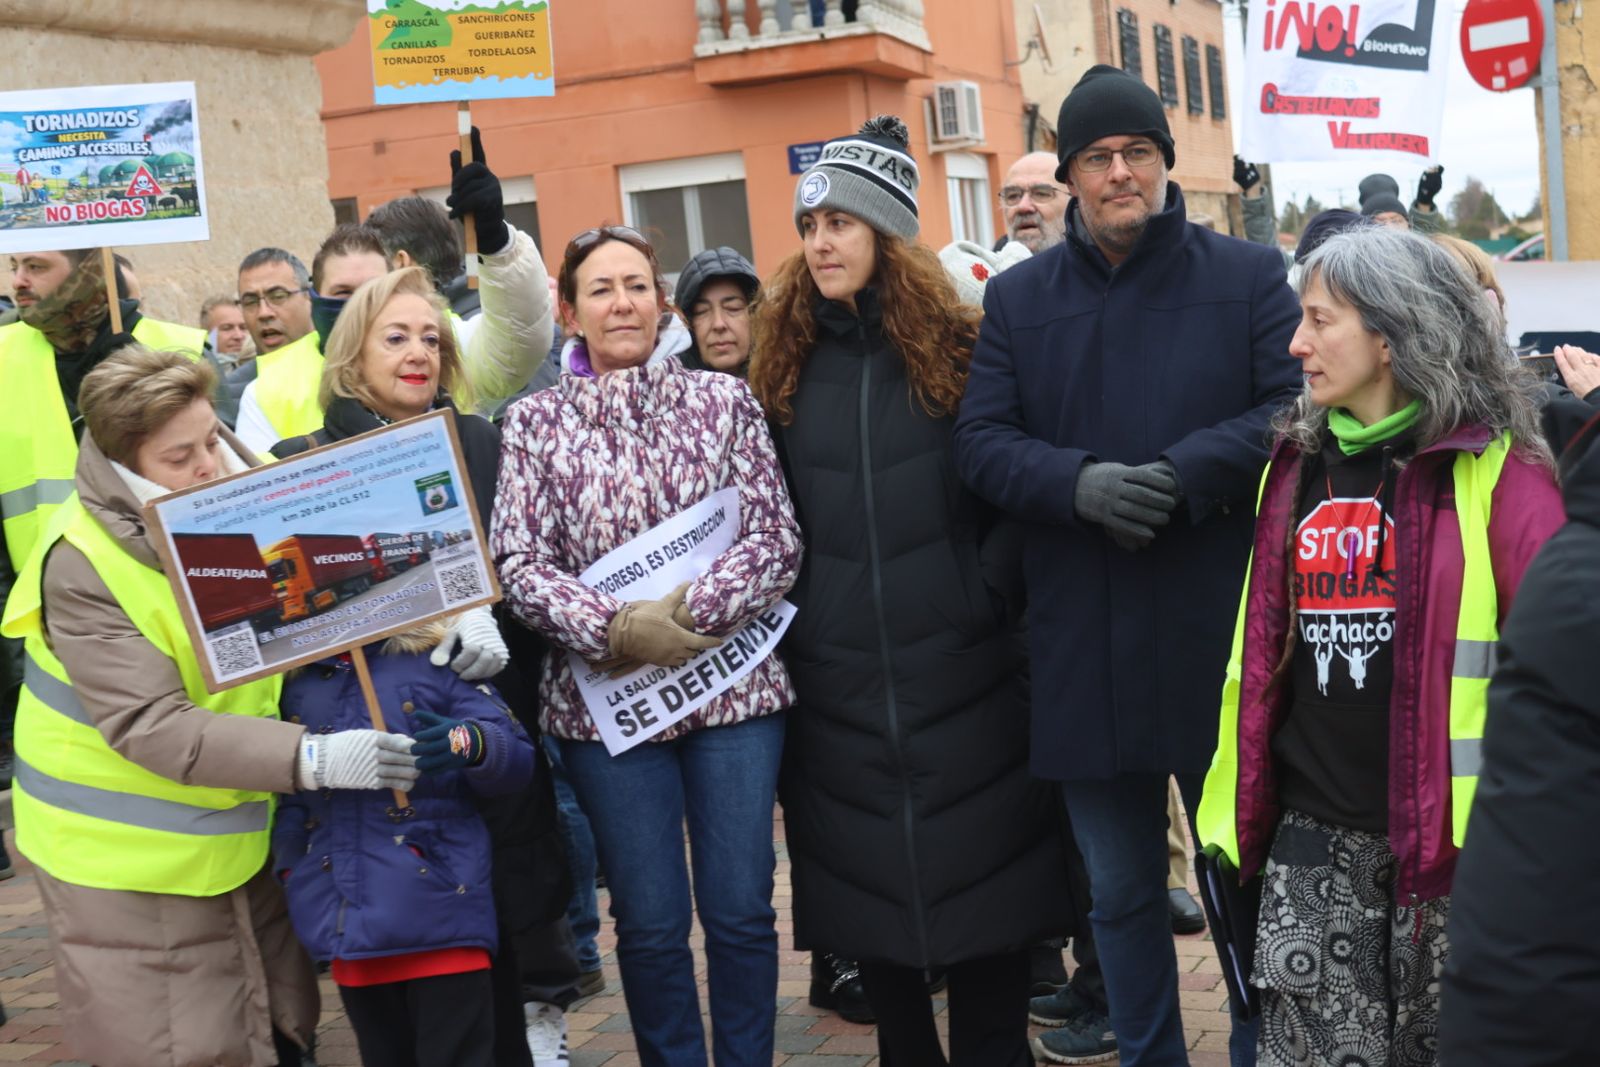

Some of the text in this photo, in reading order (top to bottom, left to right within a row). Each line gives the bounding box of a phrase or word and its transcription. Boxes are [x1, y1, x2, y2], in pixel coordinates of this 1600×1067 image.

[385, 18, 440, 29] CARRASCAL
[457, 13, 535, 25] SANCHIRICONES
[1263, 0, 1360, 57] ¡NO!
[474, 29, 535, 41] GUERIBAÑEZ
[391, 40, 438, 50] CANILLAS
[468, 46, 536, 57] TORDELALOSA
[384, 55, 445, 66] TORNADIZOS
[433, 66, 485, 77] TERRUBIAS
[23, 109, 141, 133] TORNADIZOS
[58, 131, 106, 143] NECESITA
[18, 144, 76, 163] CAMINOS
[45, 199, 145, 223] NO BIOGAS
[203, 496, 214, 505] la
[273, 474, 287, 484] no
[288, 470, 301, 480] se
[374, 443, 388, 453] de
[388, 430, 434, 449] camiones
[263, 485, 297, 501] centro
[298, 479, 313, 490] del
[315, 467, 352, 487] pueblo
[352, 462, 375, 475] para
[374, 447, 420, 467] abastecer
[421, 442, 441, 453] una
[403, 463, 417, 472] en
[281, 511, 297, 522] km
[299, 507, 312, 517] 20
[312, 502, 326, 513] de
[326, 499, 337, 509] la
[1299, 525, 1388, 560] STOP
[313, 551, 364, 565] VECINOS
[645, 550, 665, 571] ES
[186, 567, 268, 580] ALDEATEJADA
[344, 602, 362, 616] EN
[363, 580, 437, 609] TORNADIZOS
[615, 611, 784, 737] SE DEFIENDE
[606, 690, 624, 707] LA
[624, 667, 667, 697] SALUD
